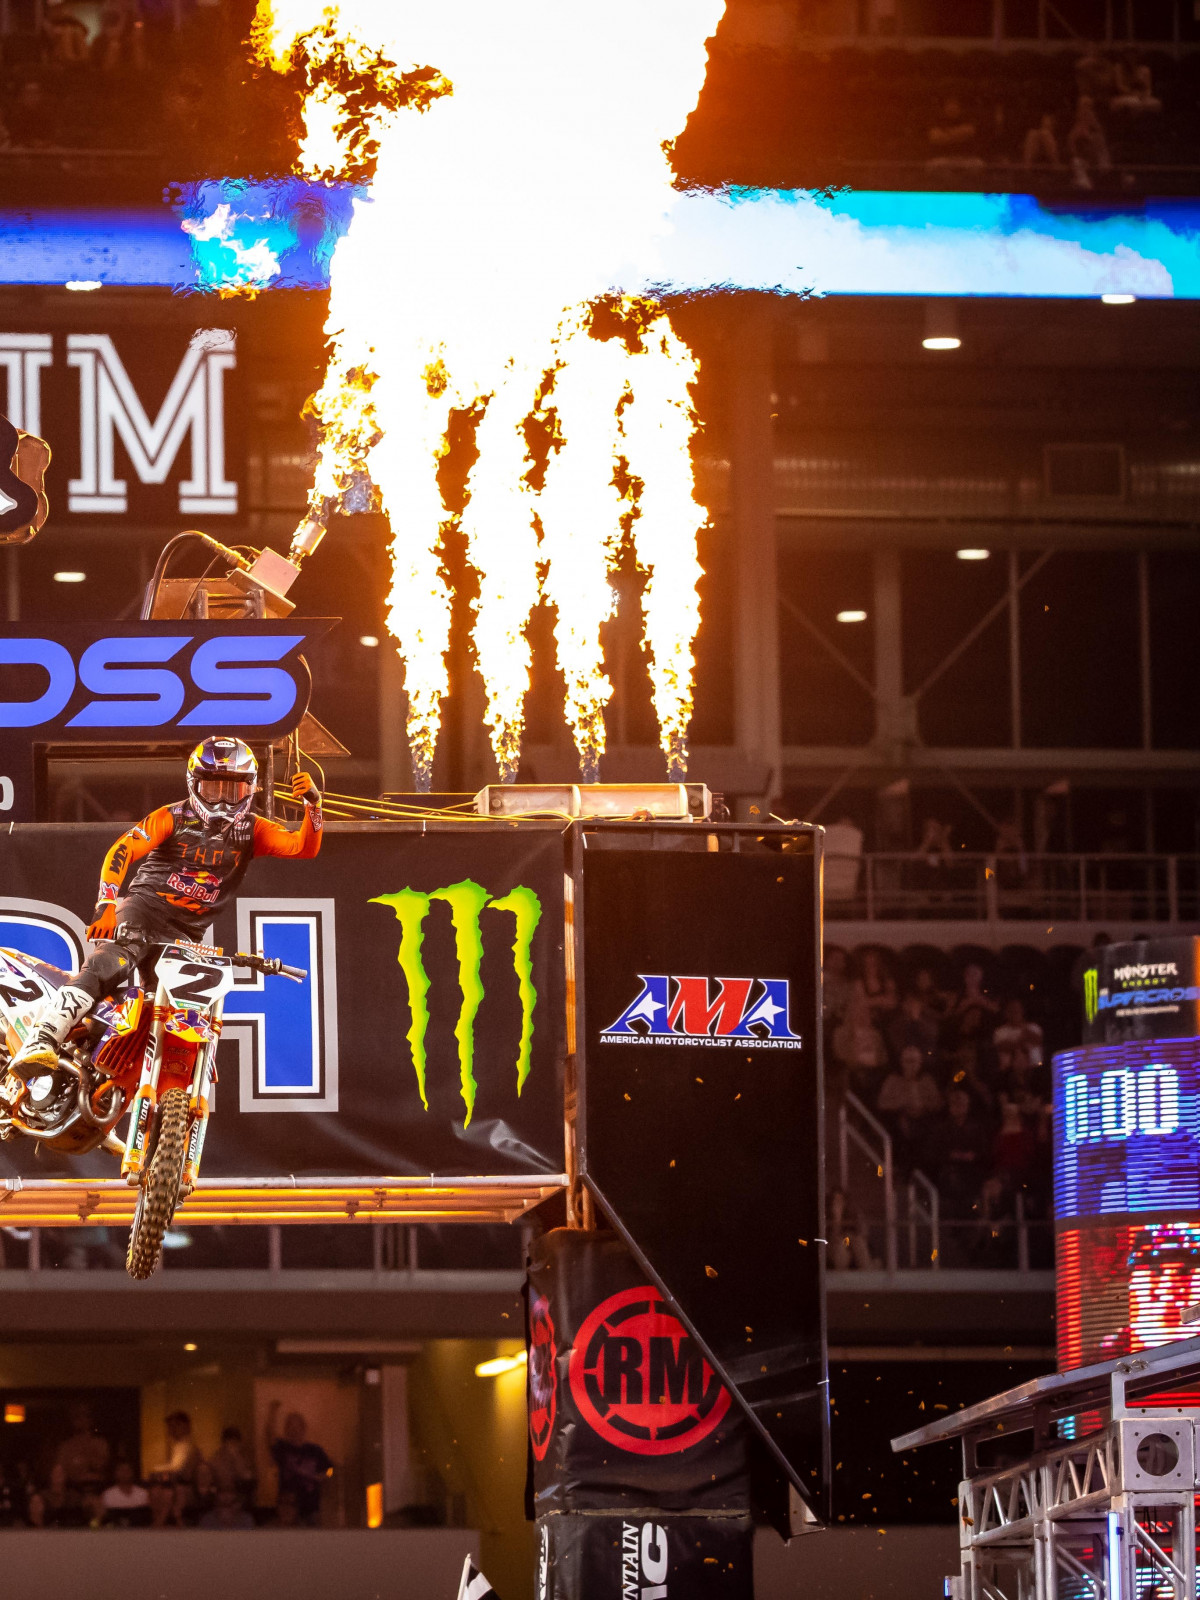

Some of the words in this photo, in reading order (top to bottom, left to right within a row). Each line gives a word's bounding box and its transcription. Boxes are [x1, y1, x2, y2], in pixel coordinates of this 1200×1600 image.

[166, 872, 198, 897] Red
[168, 964, 225, 1006] 2
[600, 974, 802, 1039] AMA
[600, 1035, 653, 1045] AMERICAN
[655, 1037, 733, 1047] MOTORCYCLIST
[734, 1039, 802, 1049] ASSOCIATION
[603, 1336, 704, 1405] RM
[622, 1521, 639, 1600] NTAIN
[641, 1522, 668, 1600] C
